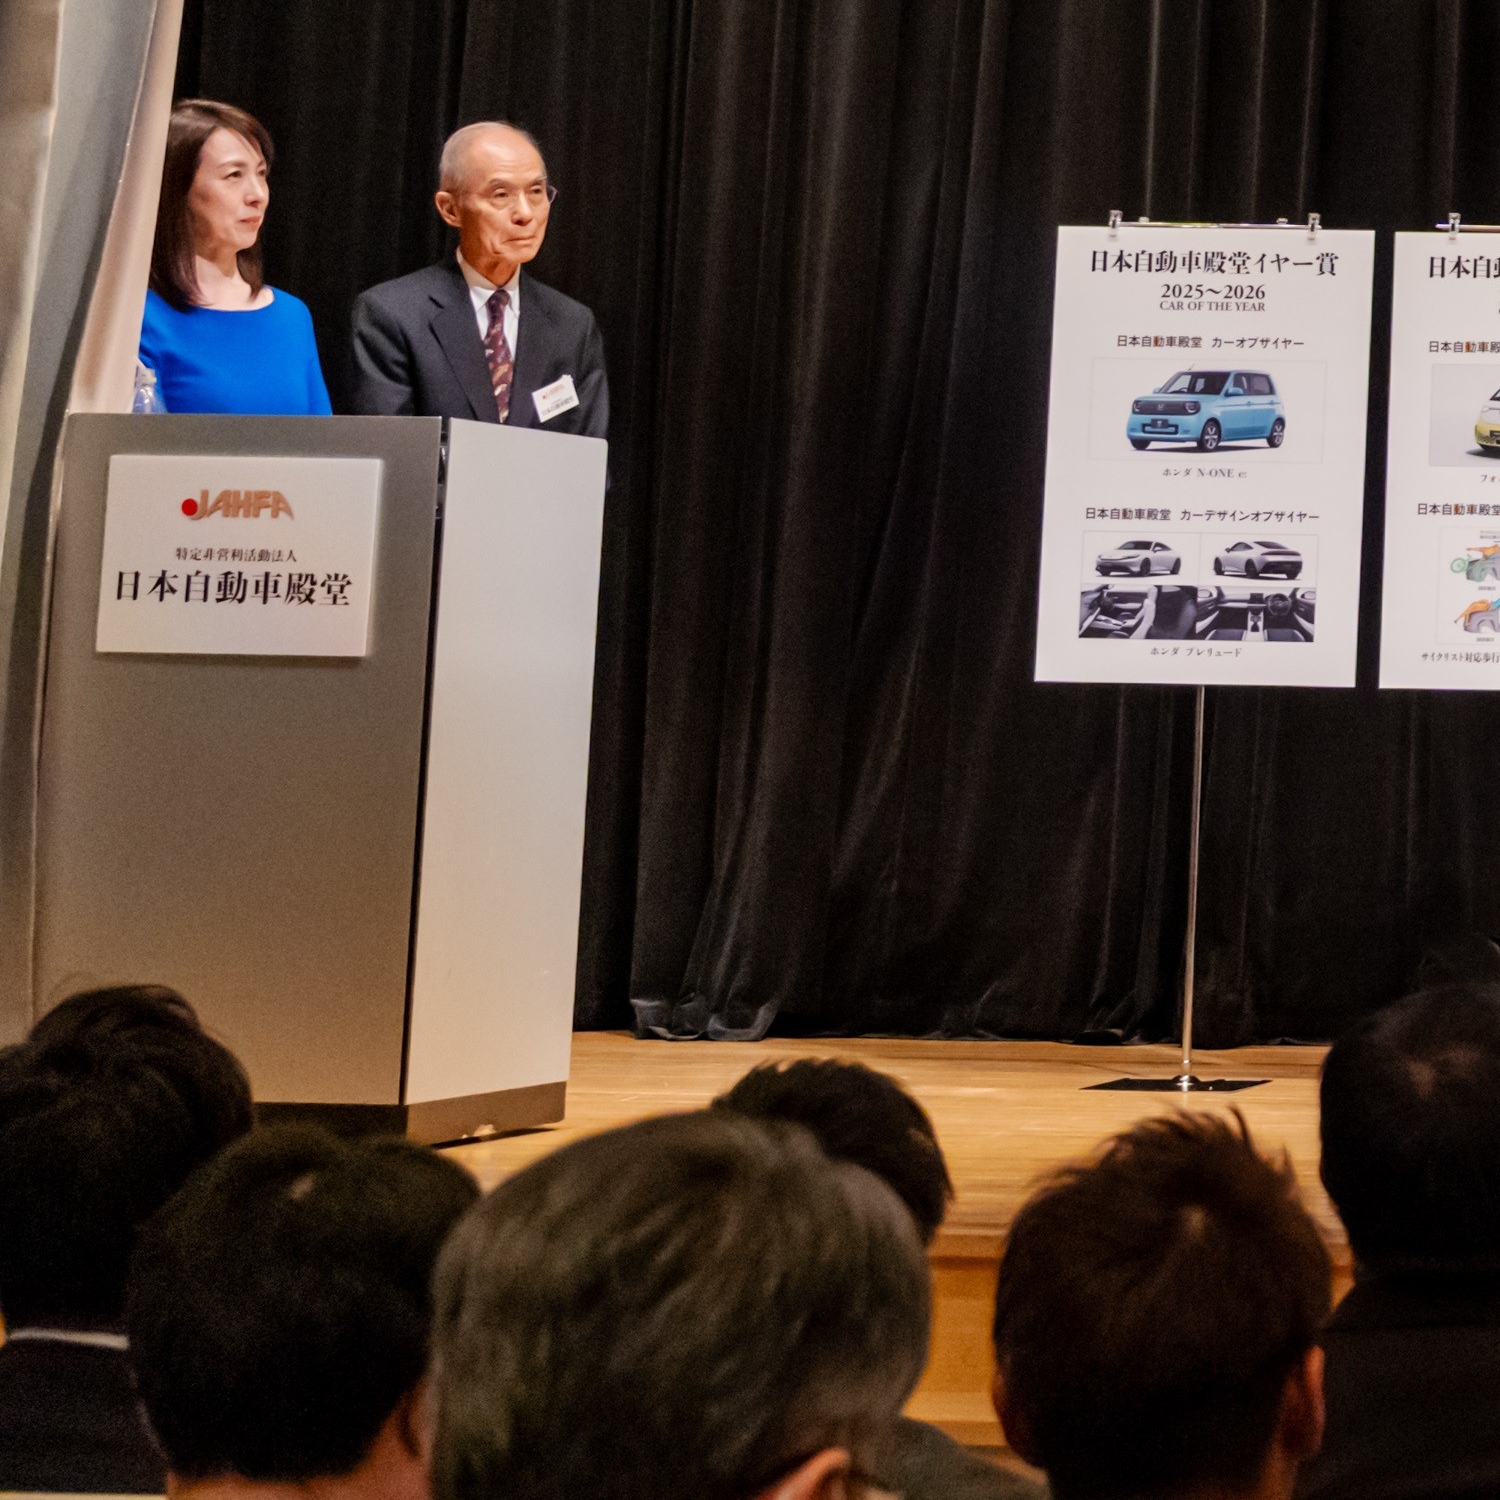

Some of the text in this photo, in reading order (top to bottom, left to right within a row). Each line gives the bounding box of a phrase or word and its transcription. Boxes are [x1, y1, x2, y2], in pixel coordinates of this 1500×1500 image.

[1091, 250, 1339, 276] 日本自動車殿堂イヤー賞
[1159, 301, 1266, 312] CAR OF THE YEAR
[1117, 335, 1202, 348] 日本自動車殿堂
[189, 489, 296, 520] JAHFA
[1085, 508, 1172, 521] 日本自動車殿堂
[175, 547, 297, 563] 特定非営利活動法人
[116, 569, 352, 606] 日本自動車殿堂
